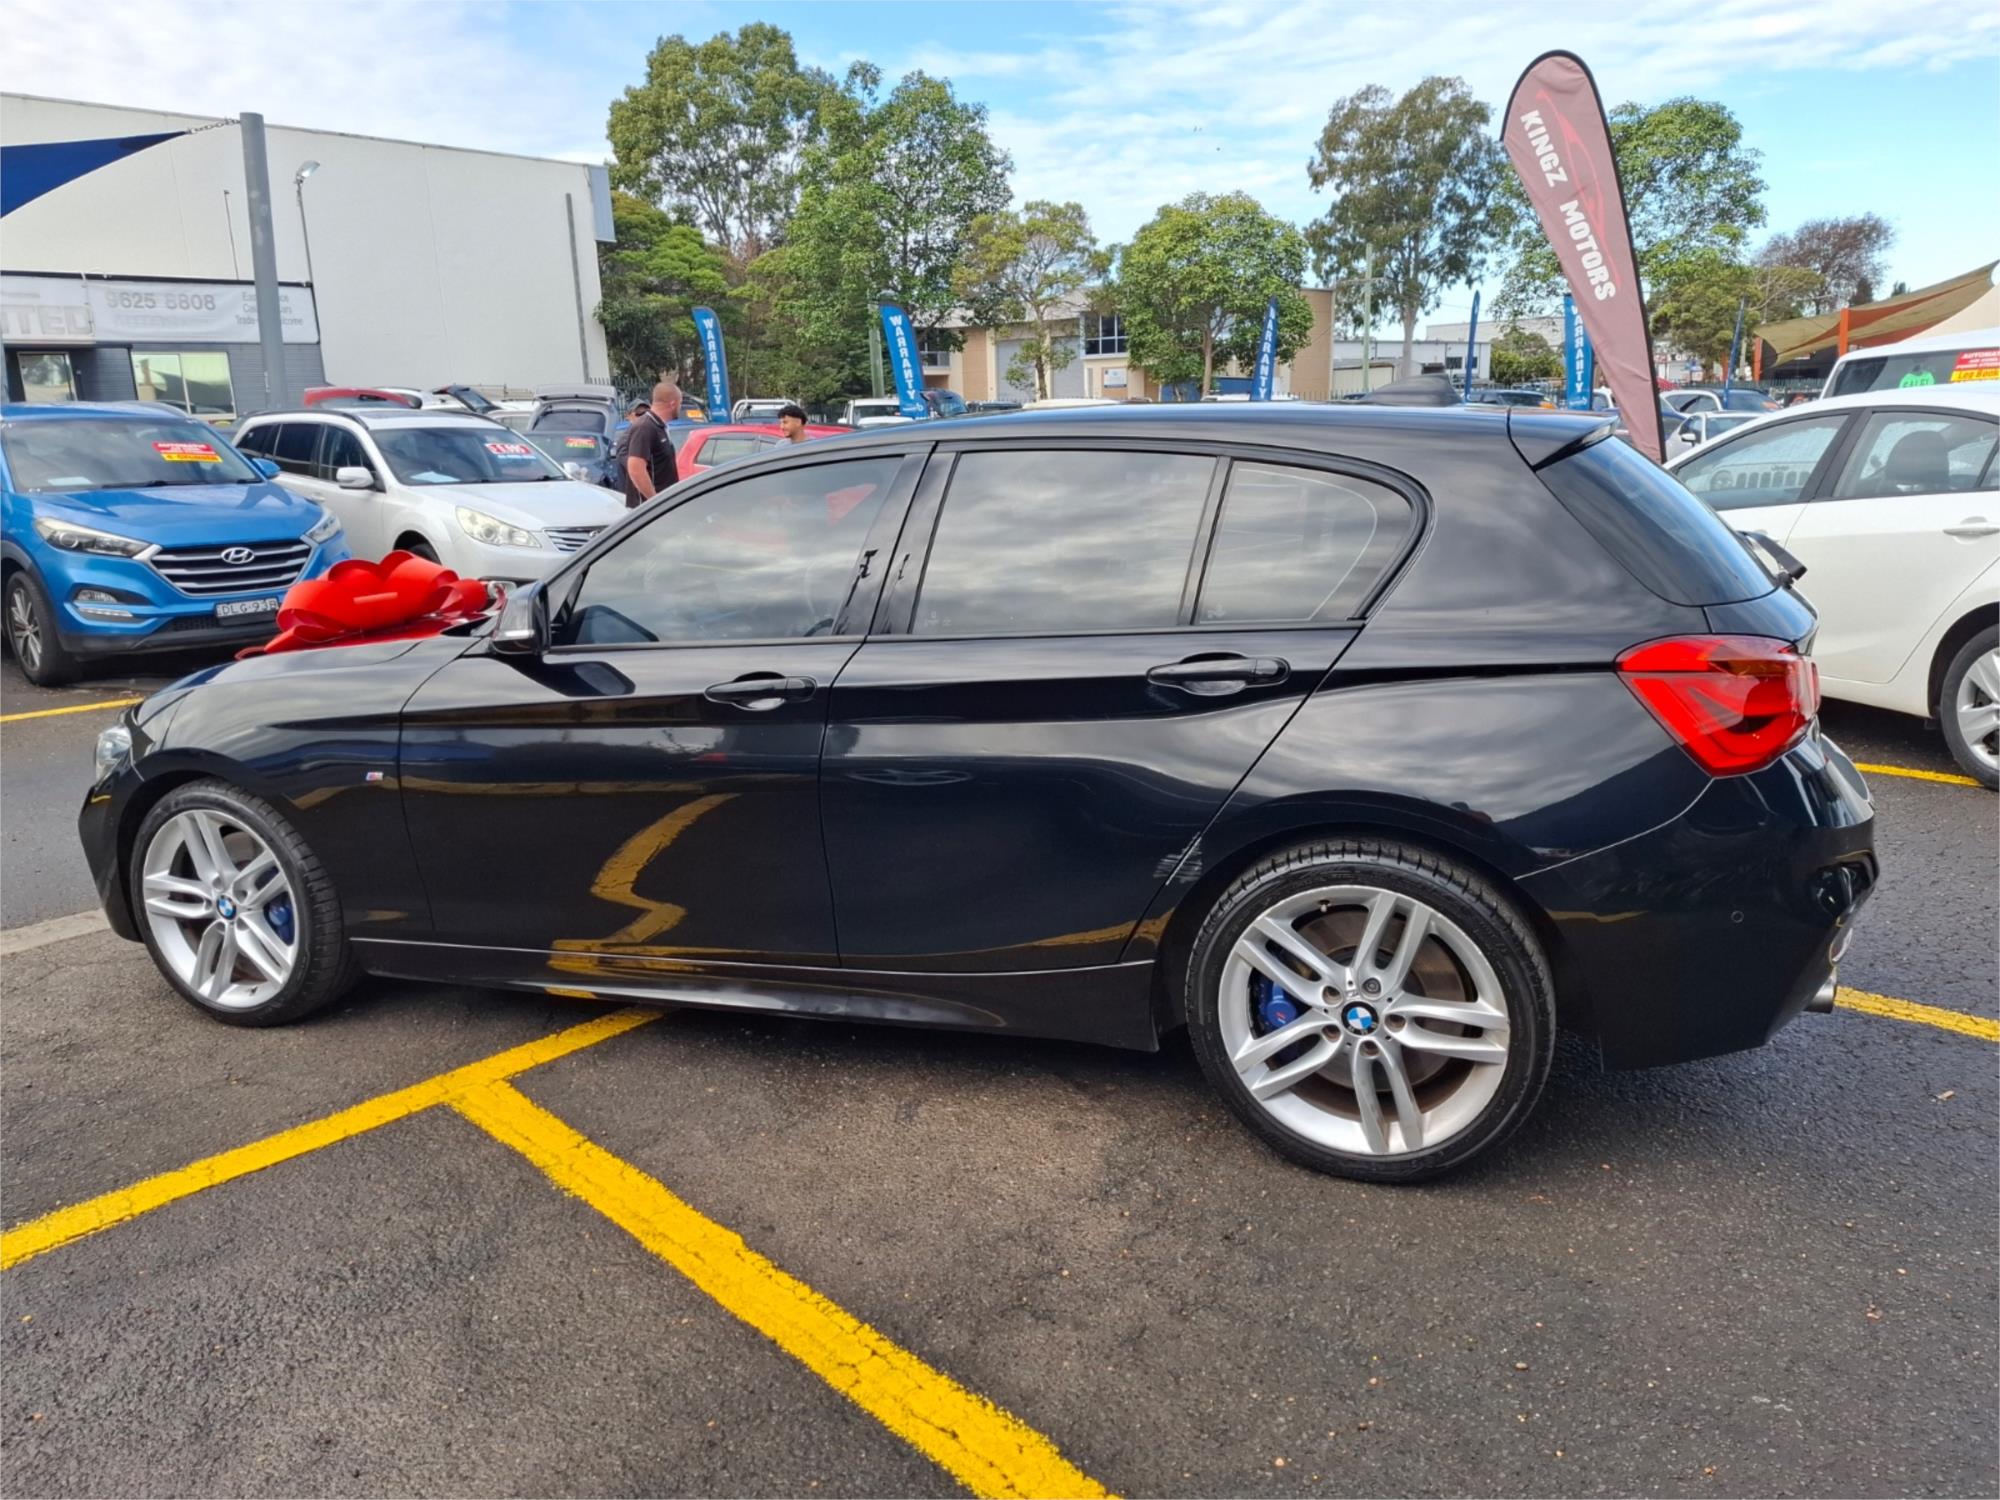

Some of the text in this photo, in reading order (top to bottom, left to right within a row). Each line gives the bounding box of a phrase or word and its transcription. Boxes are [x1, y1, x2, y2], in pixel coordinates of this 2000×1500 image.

[1520, 110, 1616, 301] KINGZ MOTORS
[703, 318, 721, 405] WARRANTY
[889, 314, 916, 400] WARRANTY
